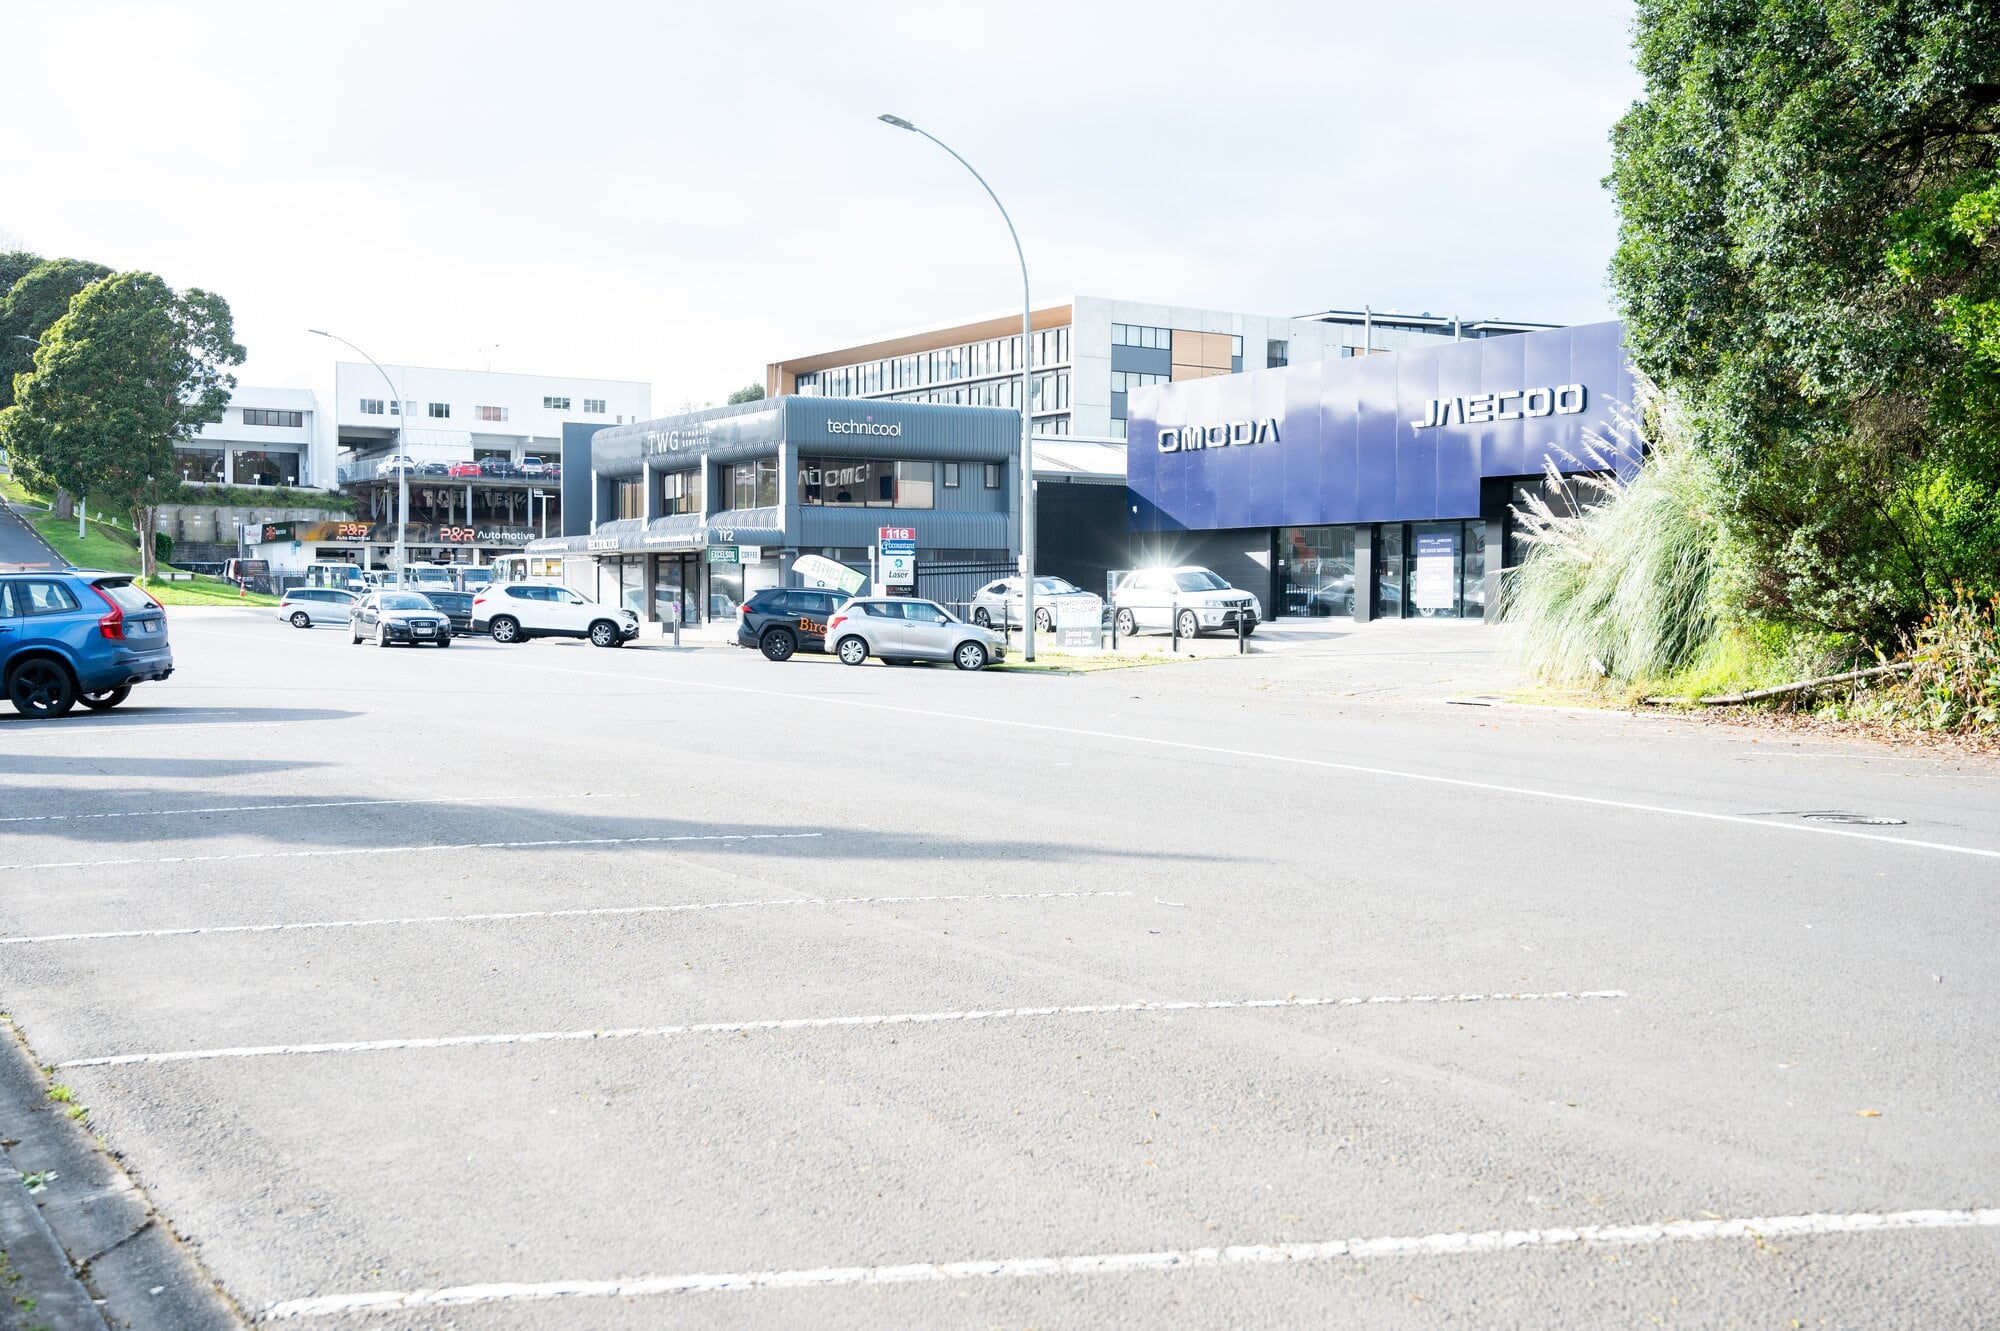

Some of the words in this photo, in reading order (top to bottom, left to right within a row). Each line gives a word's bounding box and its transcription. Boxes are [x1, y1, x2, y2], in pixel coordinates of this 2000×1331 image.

[1410, 384, 1588, 428] JAECOO
[827, 416, 901, 436] technicool
[647, 430, 679, 454] TWG
[681, 437, 711, 447] SERVICES
[1157, 418, 1280, 454] OMODA
[338, 523, 368, 536] P&R
[440, 526, 475, 541] P&R
[477, 530, 536, 540] Automotive
[718, 529, 734, 542] 112
[886, 529, 909, 539] 116
[348, 534, 371, 542] Electrical
[741, 551, 758, 559] COFFEE
